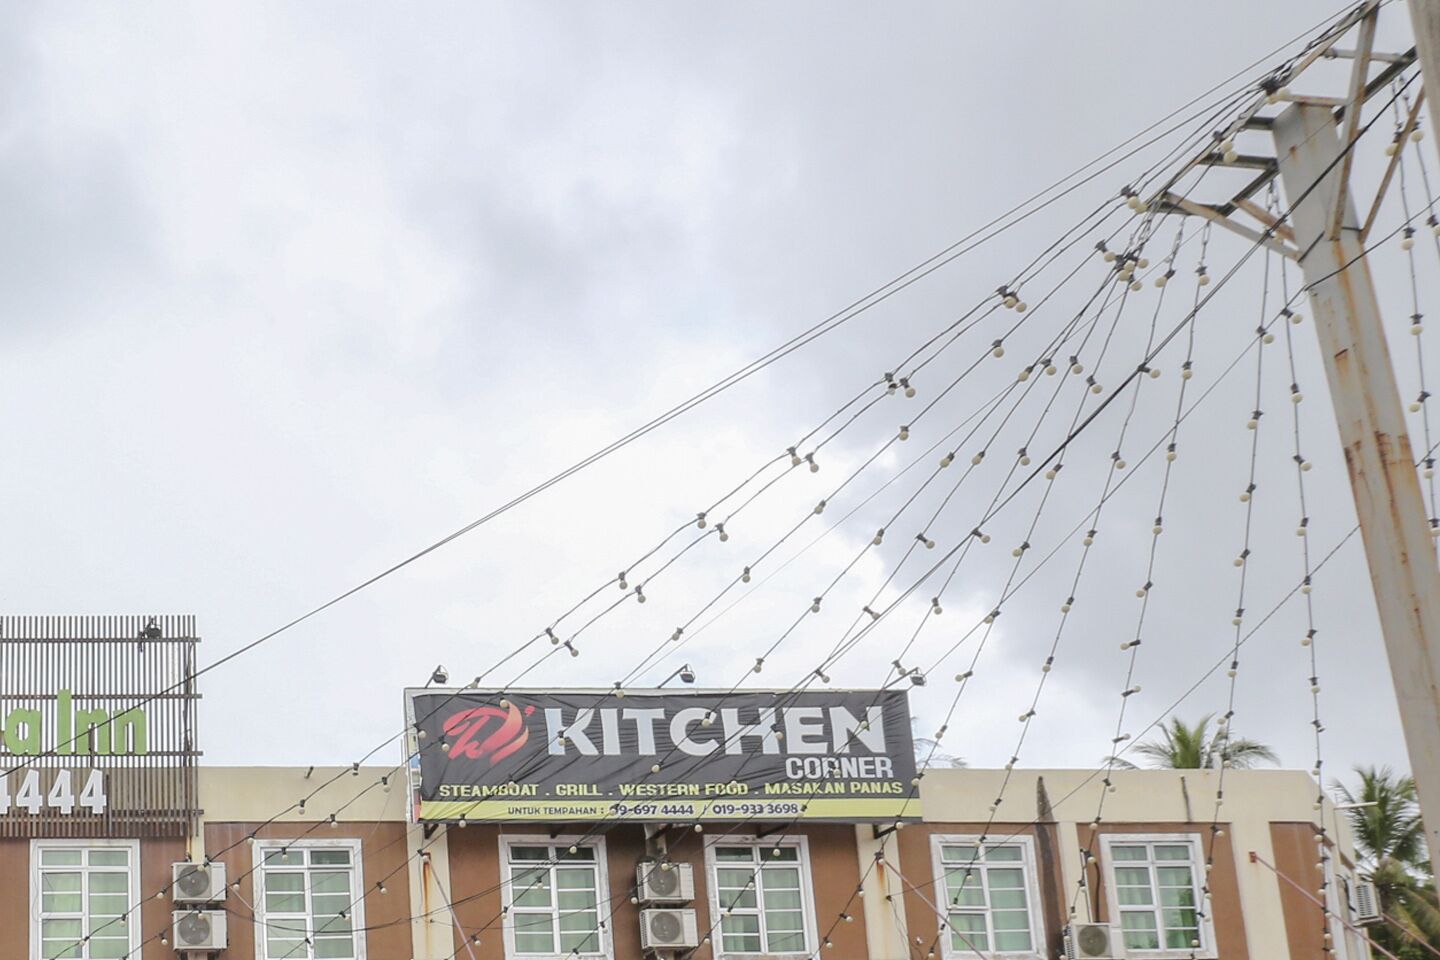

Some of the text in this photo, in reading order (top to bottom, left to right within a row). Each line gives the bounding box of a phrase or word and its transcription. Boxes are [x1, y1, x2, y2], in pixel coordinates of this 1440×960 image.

[56, 689, 148, 756] Inn
[544, 706, 886, 756] KITCHEN
[785, 757, 894, 780] CORNER
[439, 781, 904, 797] STEAMBOAT GRILL WESTERN FOOD MASAKAN PANAS
[507, 806, 541, 815] UNTUK
[543, 806, 597, 815] TEMPAHAN
[661, 804, 694, 815] 4444
[712, 804, 765, 815] 019-933
[767, 803, 799, 814] 3698
